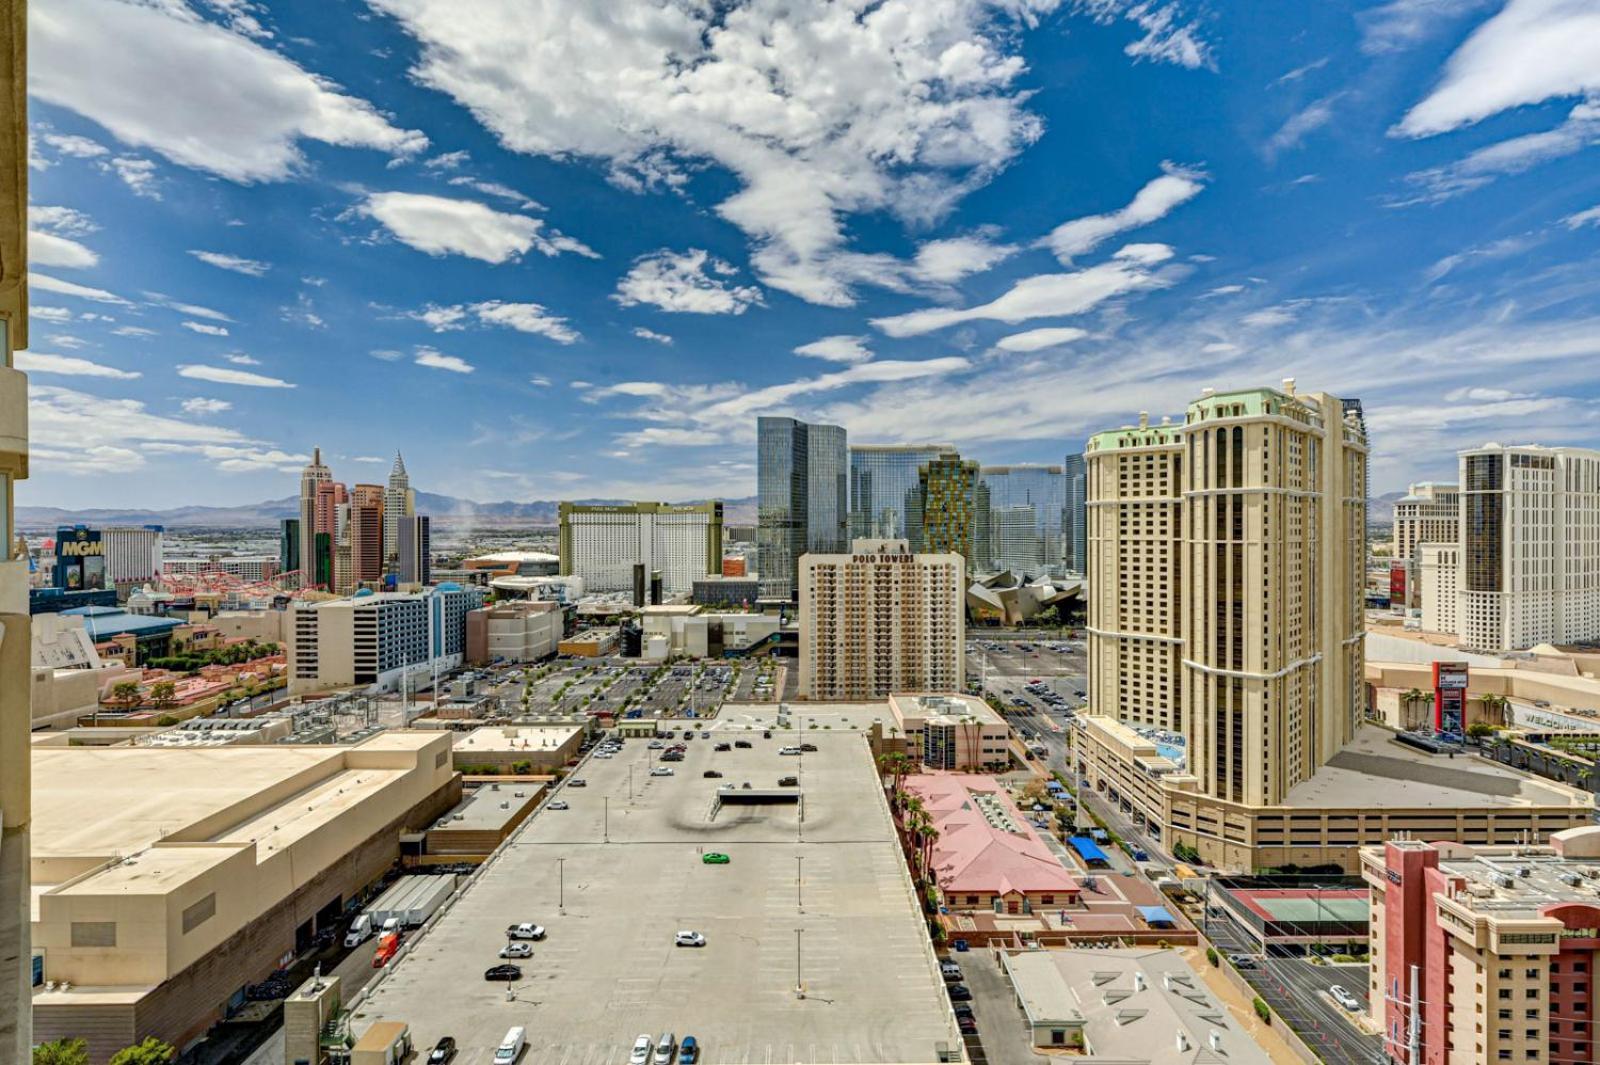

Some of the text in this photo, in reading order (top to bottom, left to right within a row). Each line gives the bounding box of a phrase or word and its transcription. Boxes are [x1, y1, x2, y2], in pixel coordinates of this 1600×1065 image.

[62, 541, 105, 556] MGM
[853, 554, 914, 564] POLO TOWERS
